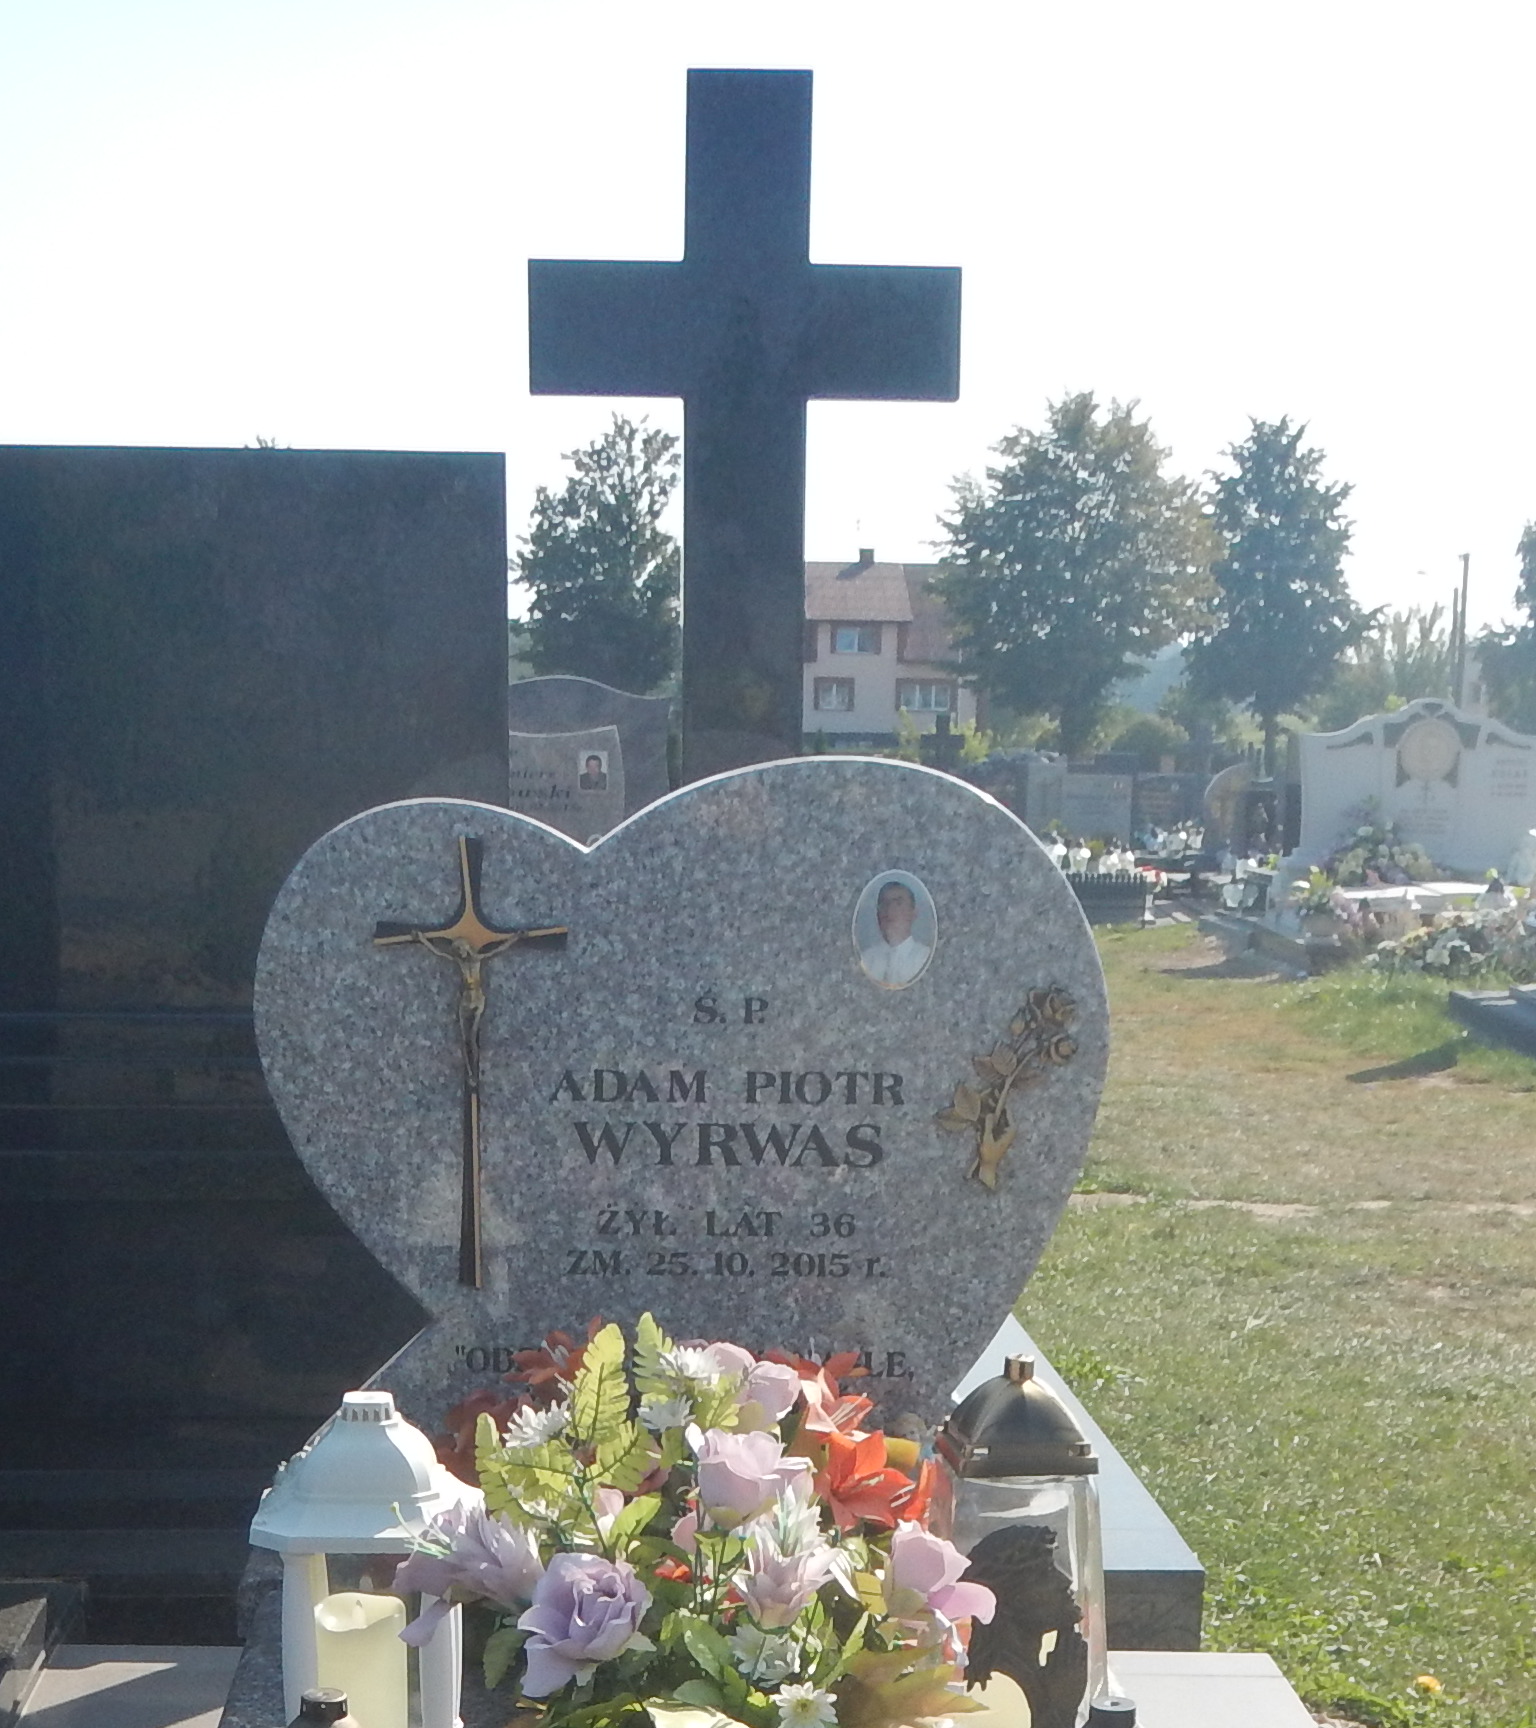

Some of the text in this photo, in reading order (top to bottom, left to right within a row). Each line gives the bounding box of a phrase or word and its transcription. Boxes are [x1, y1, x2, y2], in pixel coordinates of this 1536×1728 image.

[744, 997, 769, 1024] P.
[552, 1068, 906, 1106] ADAM PIOTR
[574, 1120, 885, 1168] WYRWAS
[597, 1203, 857, 1240] ŻYŁ LAT 36
[566, 1249, 888, 1279] ZM. 25. 10. 2015 r.
